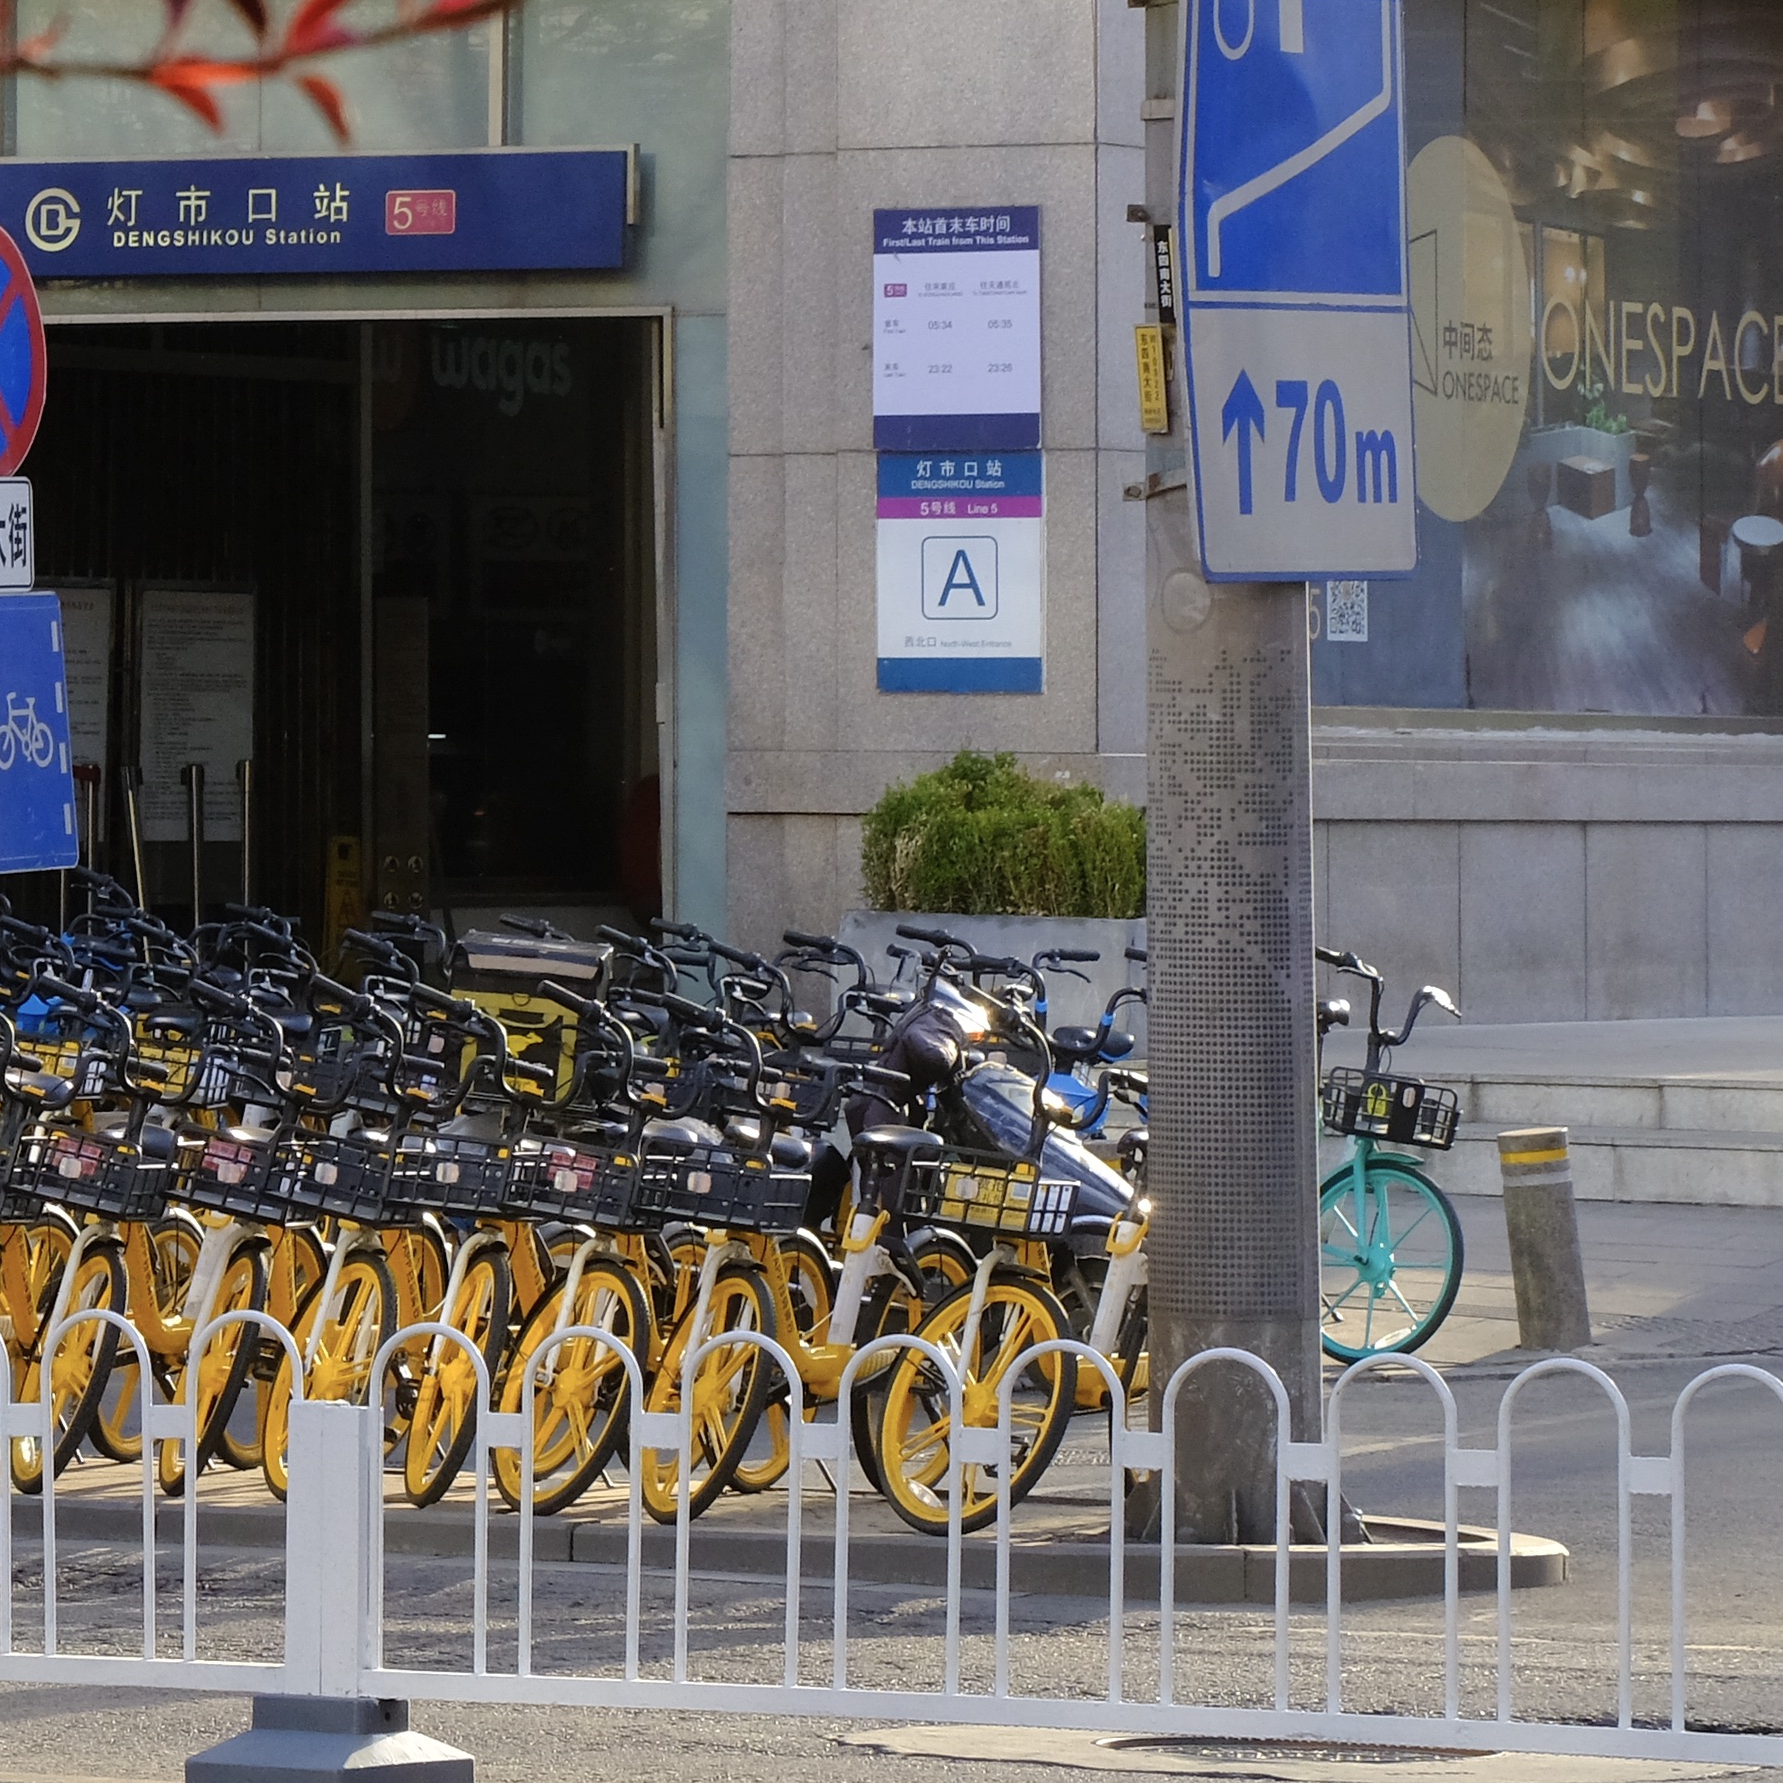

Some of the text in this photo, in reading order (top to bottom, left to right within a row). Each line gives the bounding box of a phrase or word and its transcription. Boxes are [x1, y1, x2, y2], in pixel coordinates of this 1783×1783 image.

[107, 183, 350, 227] 灯市口站
[901, 215, 1011, 235] 本站首末车时间
[113, 227, 341, 248] DENGSHIKOU Station
[926, 237, 951, 247] Train
[952, 236, 973, 245] from
[975, 236, 996, 245] This
[997, 235, 1029, 244] Station
[1157, 240, 1173, 308] 东四南大街
[1442, 320, 1493, 362] 中间态
[1442, 370, 1520, 405] ONESPACE
[917, 459, 1003, 478] 灯市口站
[911, 479, 1005, 490] DENGSHIKOU Station
[920, 501, 957, 516] 5号线
[967, 503, 989, 514] Line
[937, 549, 986, 606] A
